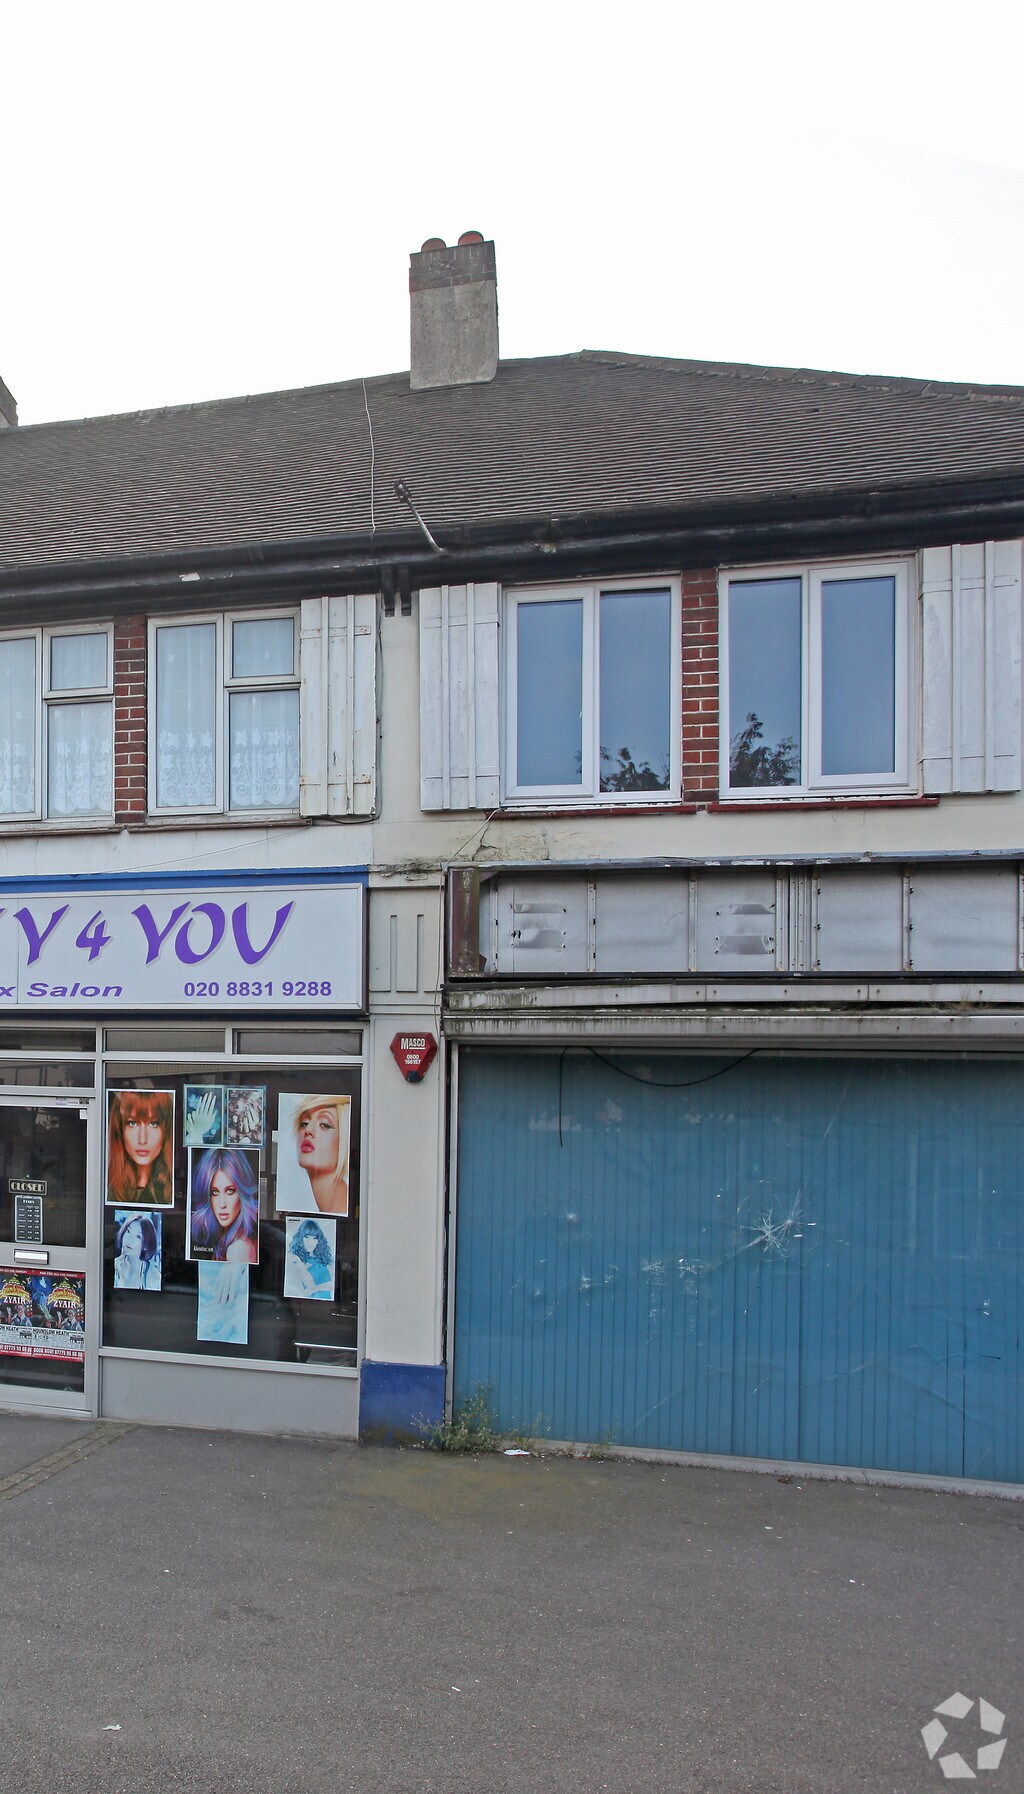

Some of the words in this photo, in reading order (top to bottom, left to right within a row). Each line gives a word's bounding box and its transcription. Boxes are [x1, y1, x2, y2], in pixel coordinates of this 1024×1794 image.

[76, 910, 112, 962] 4
[131, 900, 294, 965] YOU
[26, 982, 123, 997] Salon
[184, 981, 220, 997] 020
[226, 981, 273, 996] 8831
[282, 981, 332, 996] 9288
[400, 1038, 426, 1049] MASCO
[10, 1181, 45, 1192] CLOSED
[4, 1296, 26, 1304] ZYAIR
